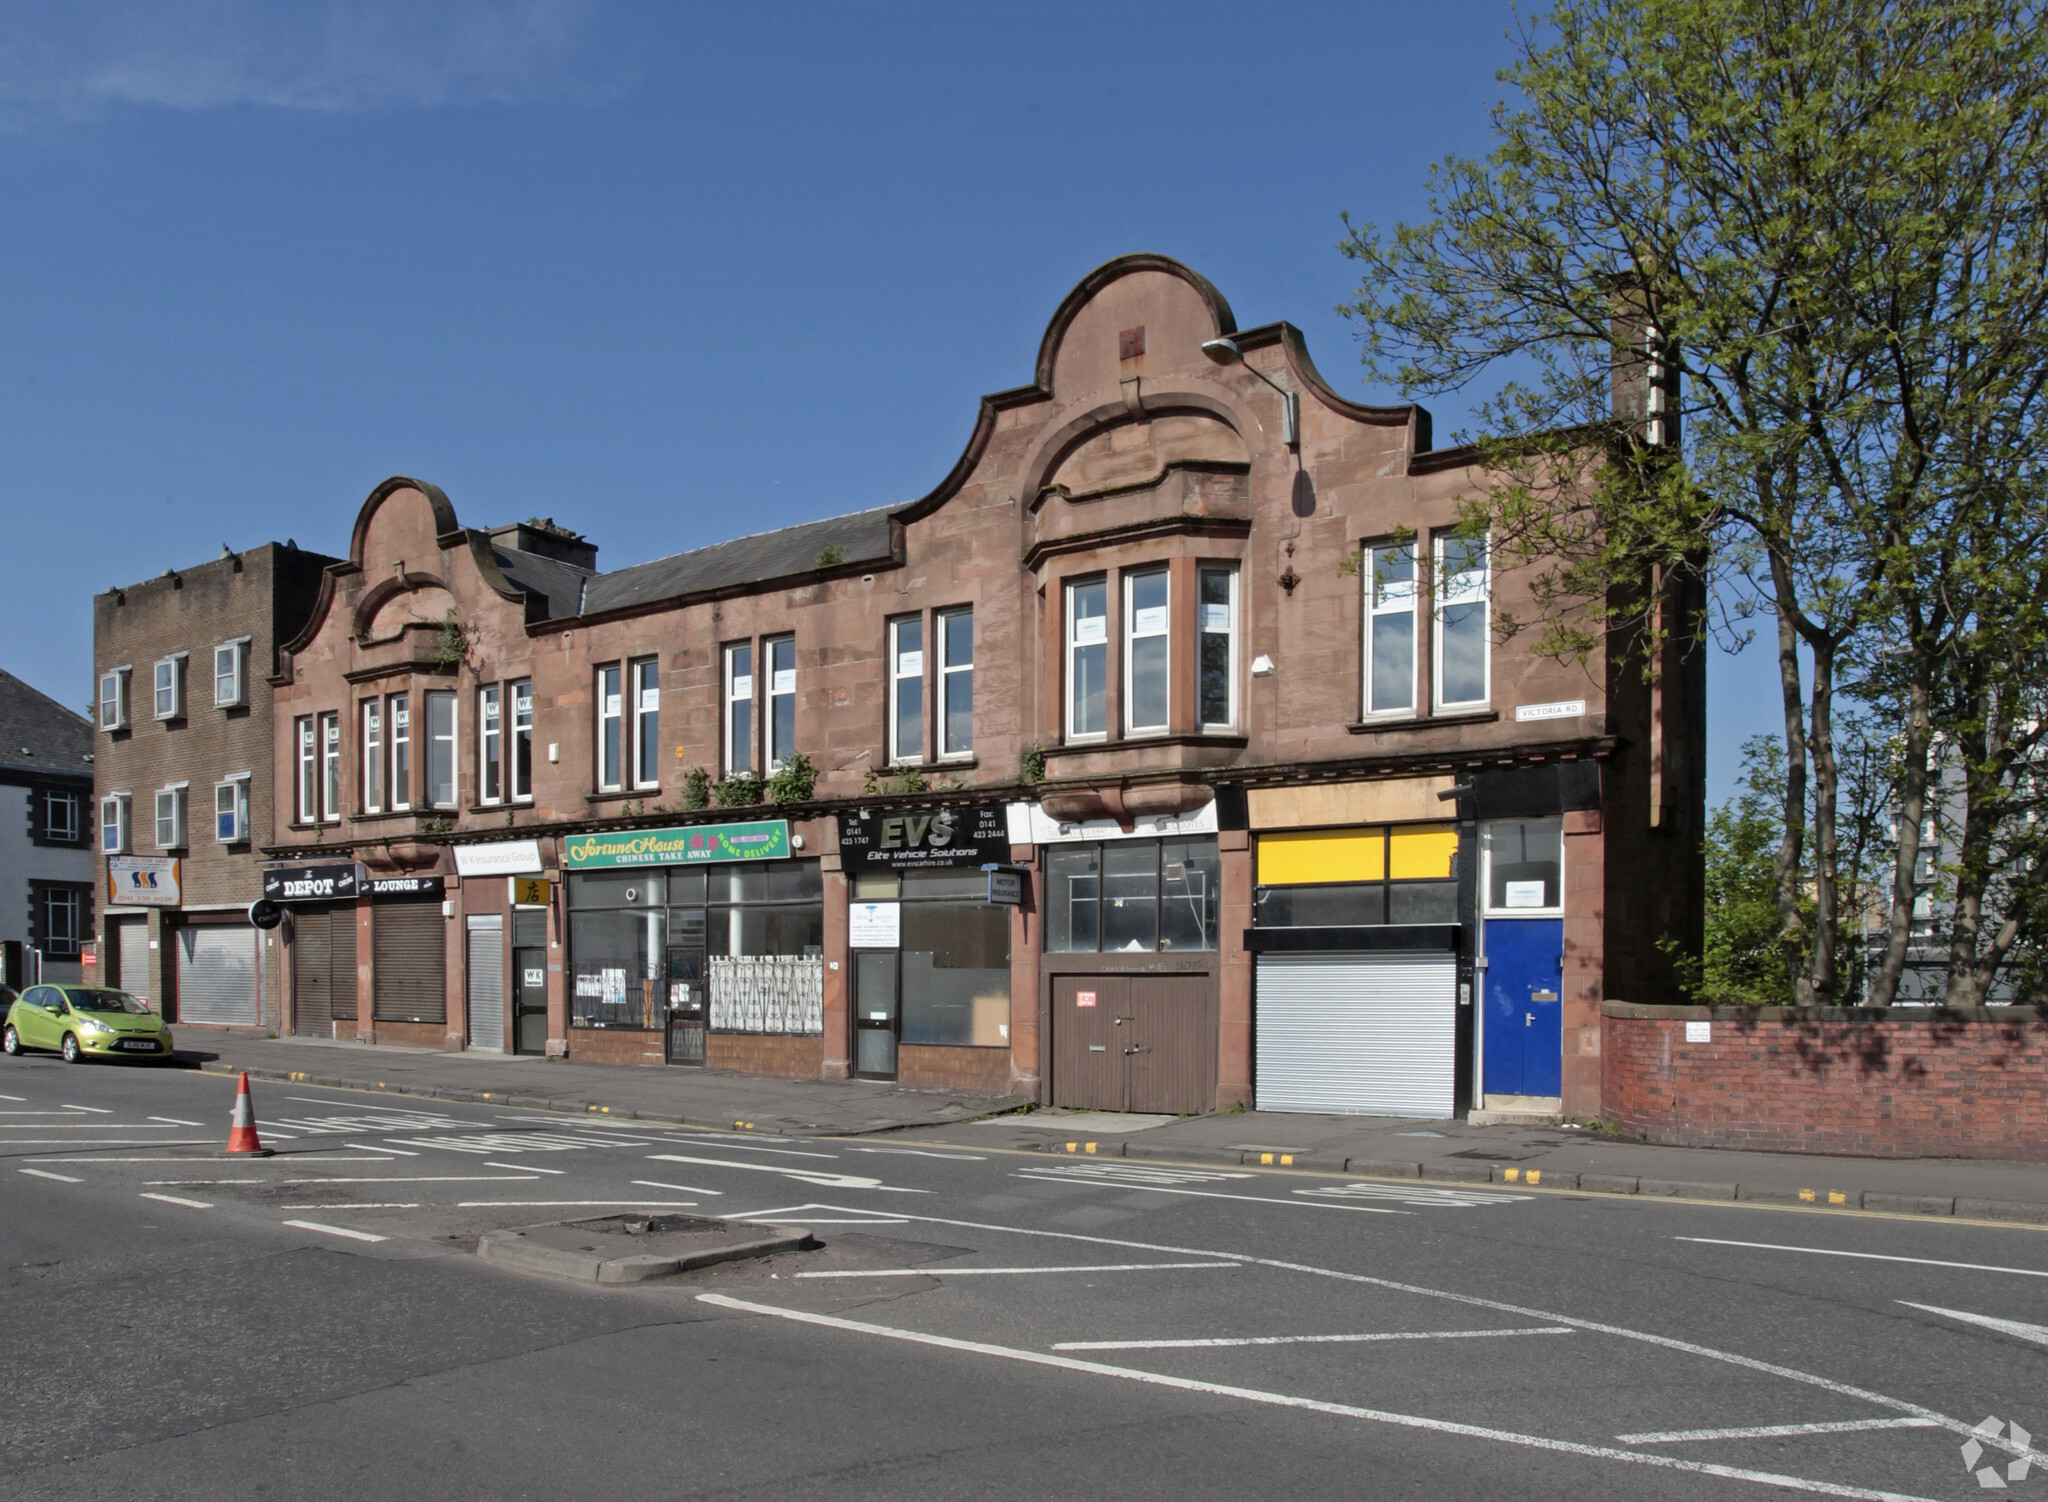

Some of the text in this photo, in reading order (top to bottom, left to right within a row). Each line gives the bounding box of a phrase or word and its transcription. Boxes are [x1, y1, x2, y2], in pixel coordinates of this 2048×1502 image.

[1522, 704, 1578, 717] VICTORIA RD
[980, 811, 994, 819] Fax:
[848, 818, 858, 826] Tel:
[979, 820, 996, 828] 0141
[846, 828, 861, 836] 0141
[880, 815, 953, 849] EVS
[973, 829, 1005, 839] 423 2444
[631, 836, 685, 854] House
[718, 828, 781, 858] HOME DELIVERY
[841, 836, 869, 845] 423 1747
[476, 855, 511, 865] Insurance
[511, 852, 536, 863] Group
[616, 849, 712, 863] CHINESE TAKE AWAY
[867, 847, 978, 861] Elite Vehicle Solutions
[891, 858, 954, 868] www.evscarhire.co.uk
[283, 878, 334, 897] DEPOT
[373, 879, 419, 892] LOUNGE
[996, 878, 1016, 887] MOTOR
[525, 881, 540, 903] 店
[993, 888, 1019, 898] INSURANCE
